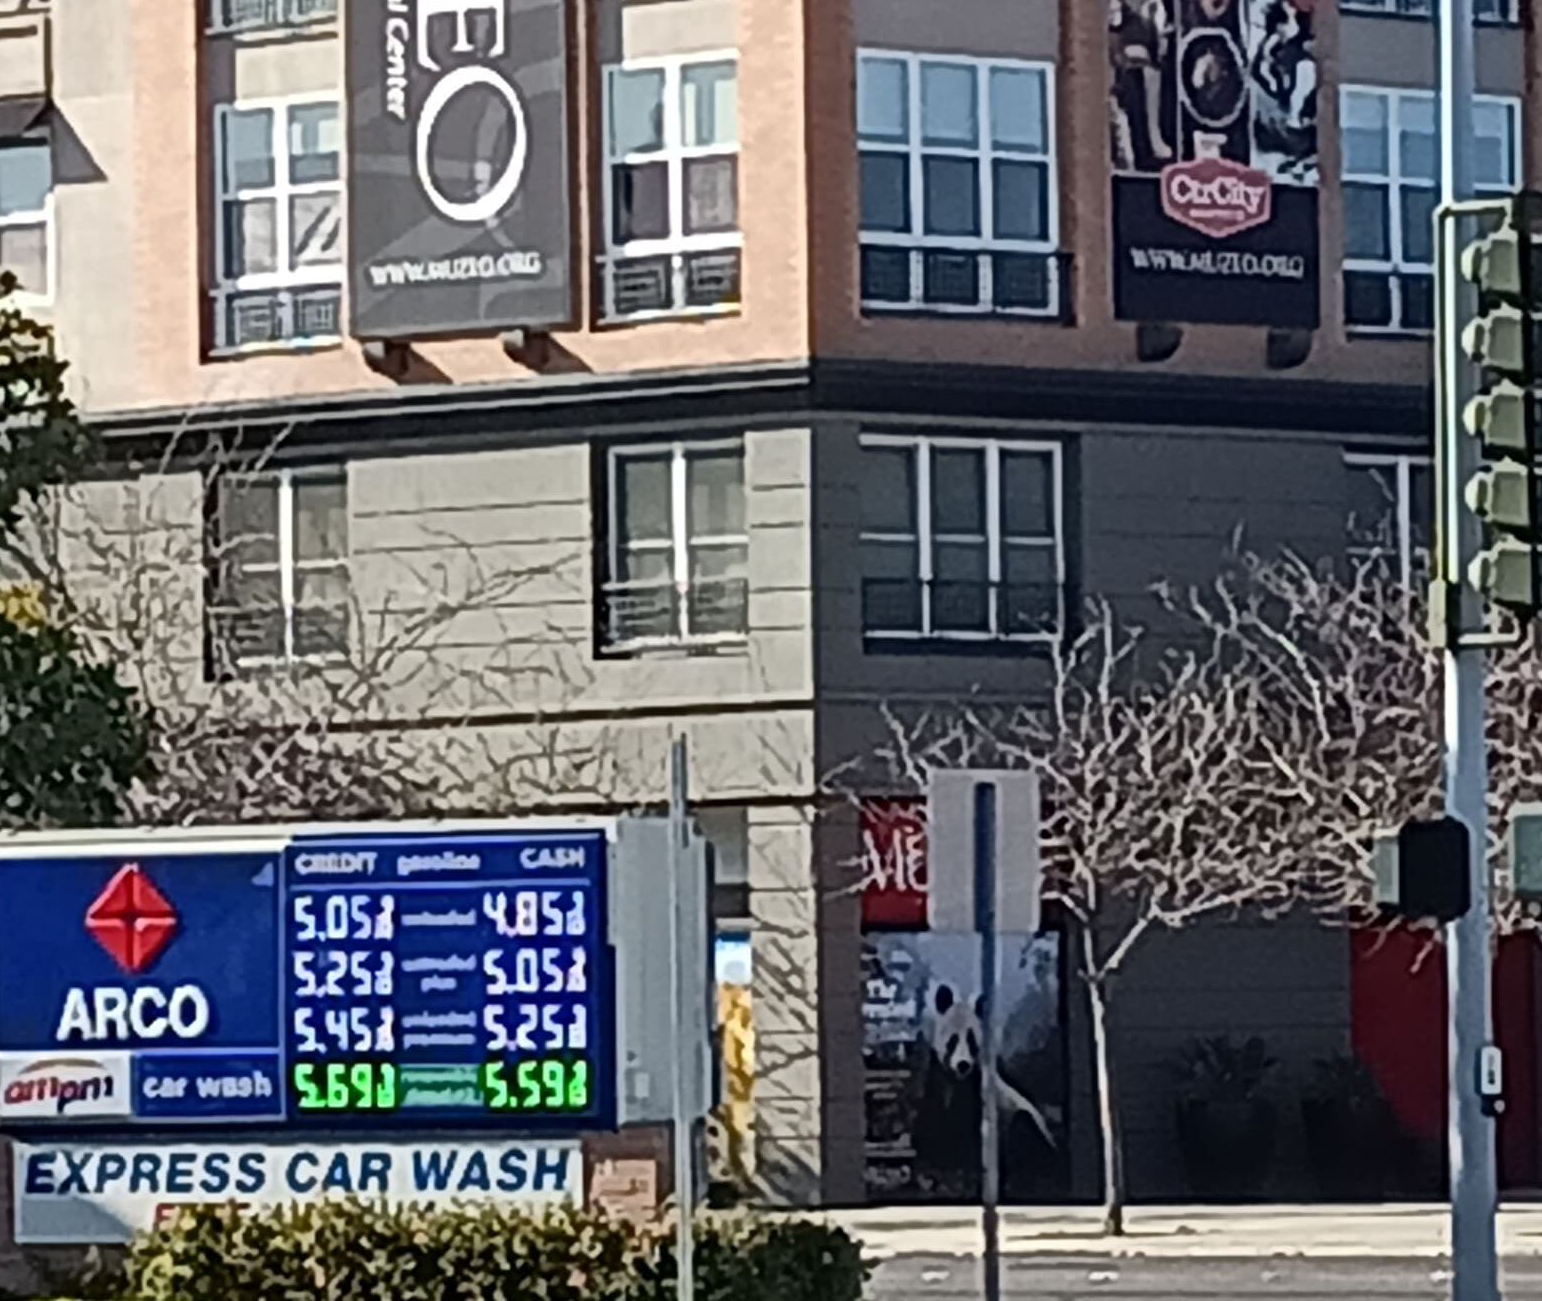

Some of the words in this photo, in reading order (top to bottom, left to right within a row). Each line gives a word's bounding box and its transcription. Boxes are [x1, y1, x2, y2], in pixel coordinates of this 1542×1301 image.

[386, 17, 409, 120] Center
[519, 847, 586, 870] CASH
[56, 984, 209, 1041] ARCO
[142, 1075, 188, 1099] car
[195, 1070, 273, 1099] wash
[25, 1152, 266, 1194] EXPRESS
[285, 1152, 392, 1194] CAR
[412, 1149, 571, 1192] WASH
